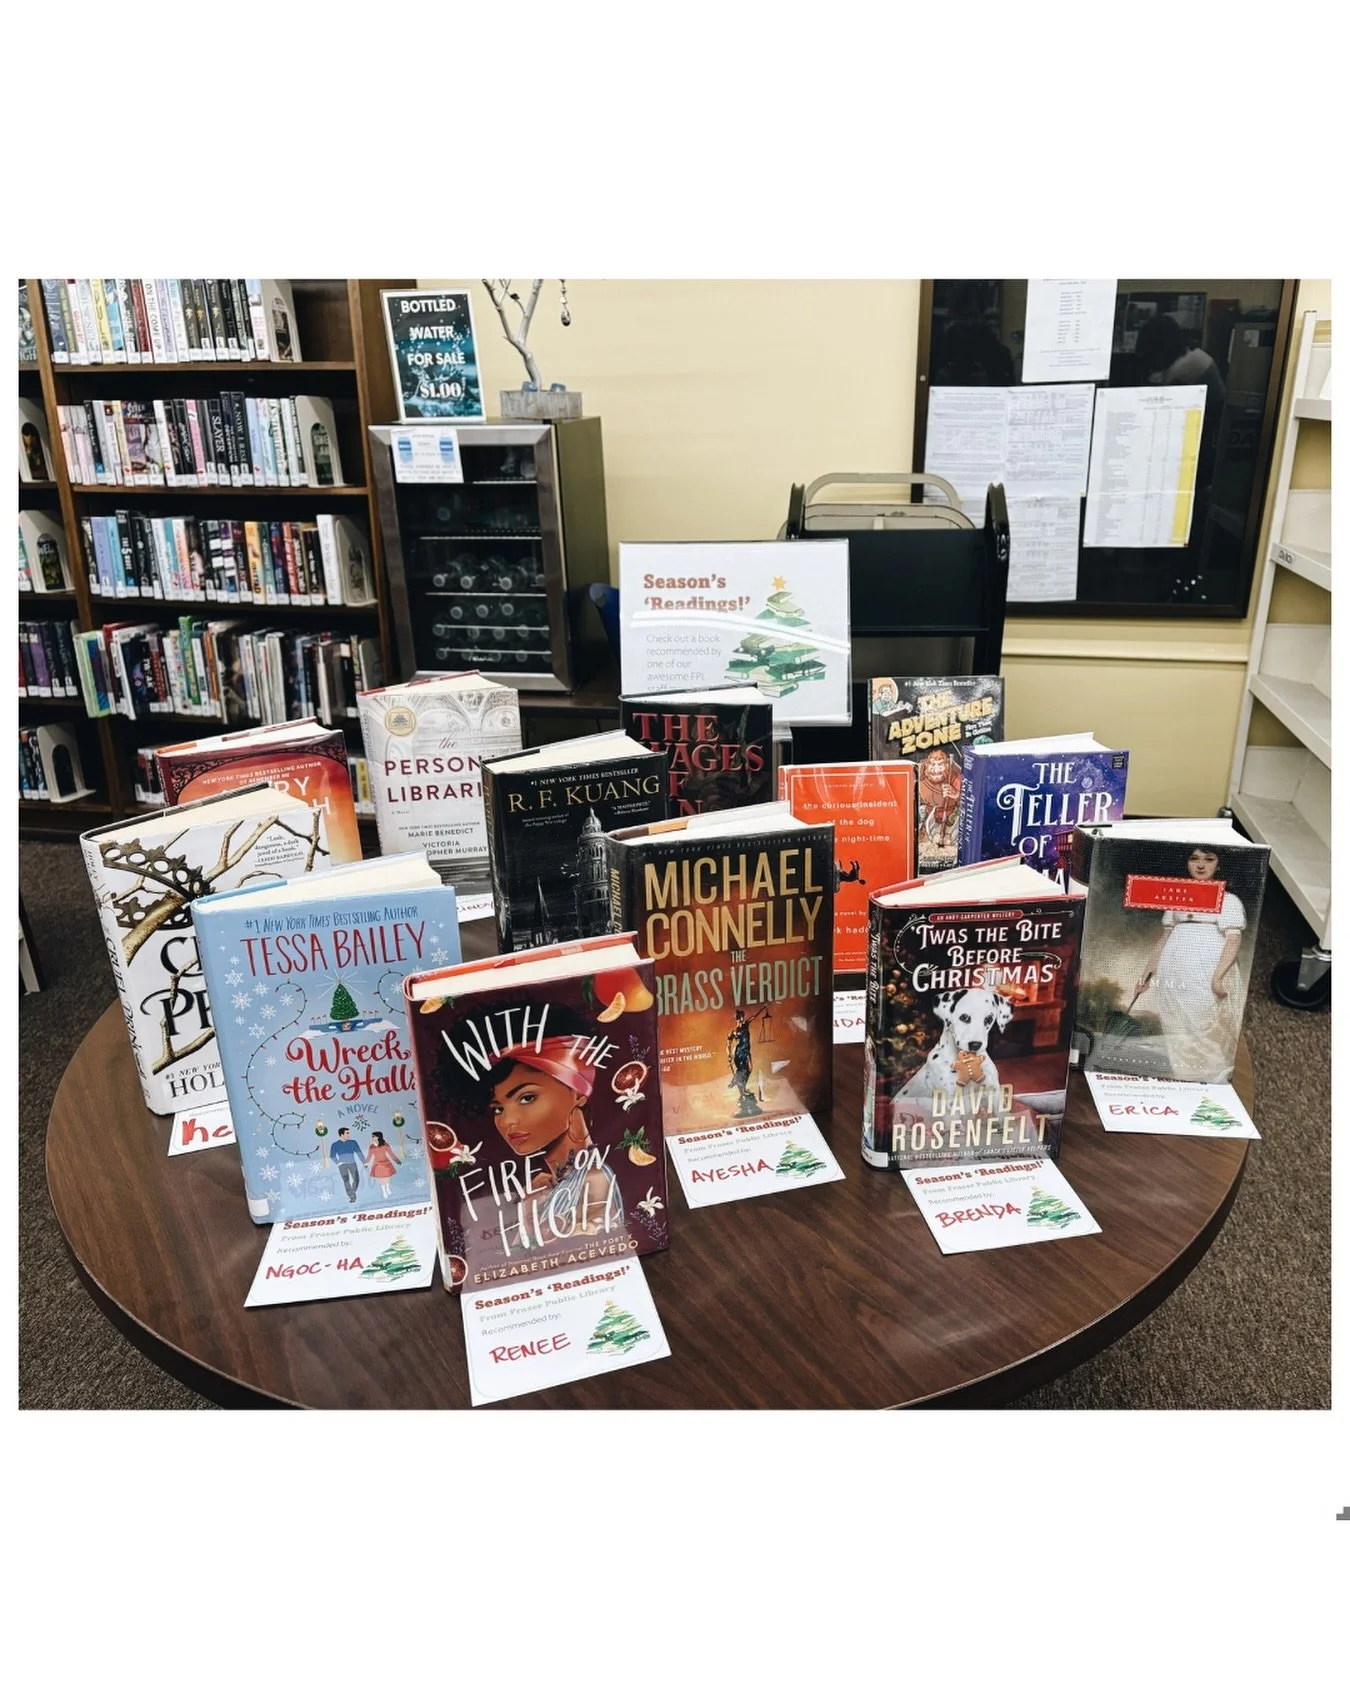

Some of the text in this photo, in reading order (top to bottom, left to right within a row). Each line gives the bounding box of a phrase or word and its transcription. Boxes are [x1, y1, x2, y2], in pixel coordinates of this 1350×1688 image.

[400, 298, 456, 314] BOTTLED
[150, 313, 160, 338] COME
[409, 325, 455, 341] WATER
[407, 352, 466, 367] FOR SALE
[419, 381, 463, 399] $1.00
[212, 416, 226, 452] SLAYER
[643, 574, 727, 589] Season's
[644, 596, 751, 612] 'Readings!'
[646, 633, 672, 643] Check
[674, 635, 689, 643] out
[698, 633, 721, 643] book
[647, 647, 722, 657] recommended by
[665, 659, 675, 668] of
[648, 672, 705, 681] awesome FPL
[917, 688, 953, 712] THE
[632, 712, 720, 742] THE
[888, 697, 993, 741] ADVENTURE
[438, 735, 458, 749] the
[902, 723, 962, 755] ZONE
[254, 766, 296, 777] BESTSELLING
[296, 761, 322, 769] AUTHOR
[385, 756, 482, 776] PERSON
[650, 742, 765, 772] AGES
[540, 778, 557, 786] NEW
[558, 775, 577, 783] YORK
[601, 767, 639, 778] BESTSELLER
[1032, 762, 1077, 784] THE
[387, 782, 481, 803] LIBRARI
[508, 775, 661, 814] R. F. KUANG
[821, 801, 856, 809] curious
[996, 783, 1113, 847] TELLER
[435, 828, 474, 836] BENEDICT
[839, 818, 854, 826] the
[857, 818, 875, 827] dog
[422, 840, 460, 848] VICTORIA
[456, 846, 487, 854] MURRAY
[842, 834, 891, 844] night-time
[1019, 834, 1053, 858] OF
[644, 848, 824, 911] MICHAEL
[610, 868, 622, 921] MICHAEL
[1154, 895, 1194, 903] AUSTEN
[244, 905, 418, 934] #1 NEW YORK TIMES BESTSELLING AUTHOR
[646, 896, 824, 960] CONNELLY
[975, 927, 1009, 943] THE
[1016, 919, 1062, 942] BITE
[240, 933, 329, 977] TESSA
[332, 921, 426, 969] BAILEY
[731, 950, 747, 963] THE
[947, 945, 1023, 967] BEFORE
[106, 936, 126, 993] CRUEL
[730, 956, 823, 1007] VERDICT
[912, 964, 1057, 992] CHRISTMAS
[1138, 978, 1187, 990] EMMA
[869, 980, 880, 1004] BITE
[285, 1029, 411, 1074] Wreck
[441, 1004, 550, 1082] WITH
[569, 1033, 620, 1070] THE
[180, 1066, 200, 1078] NEW
[203, 1062, 221, 1071] YOR
[169, 1071, 225, 1099] HOL
[282, 1076, 336, 1105] the
[337, 1104, 380, 1119] A NOVEL
[932, 1083, 1014, 1117] DAVID
[678, 1116, 803, 1144] Season's 'Readings!'
[891, 1114, 1052, 1152] ROSENFELT
[459, 1144, 611, 1221] FIRE ON
[691, 1158, 774, 1184] AYESHA
[915, 1160, 1044, 1185] Season's 'Readings!'
[283, 1206, 433, 1230] Season's 'Readings!'
[498, 1174, 617, 1257] HIGH
[935, 1202, 1022, 1228] BRENDA
[280, 1222, 412, 1242] From Fraser Public Library
[603, 1235, 624, 1245] POET
[276, 1241, 339, 1254] Recommended
[473, 1239, 639, 1285] ELIZABETH ACEVEDO
[474, 1265, 632, 1311] Season's 'Readings!'
[480, 1285, 616, 1323] From Fraser Public Library
[481, 1314, 547, 1337] Recommended
[489, 1332, 572, 1364] RENEE
